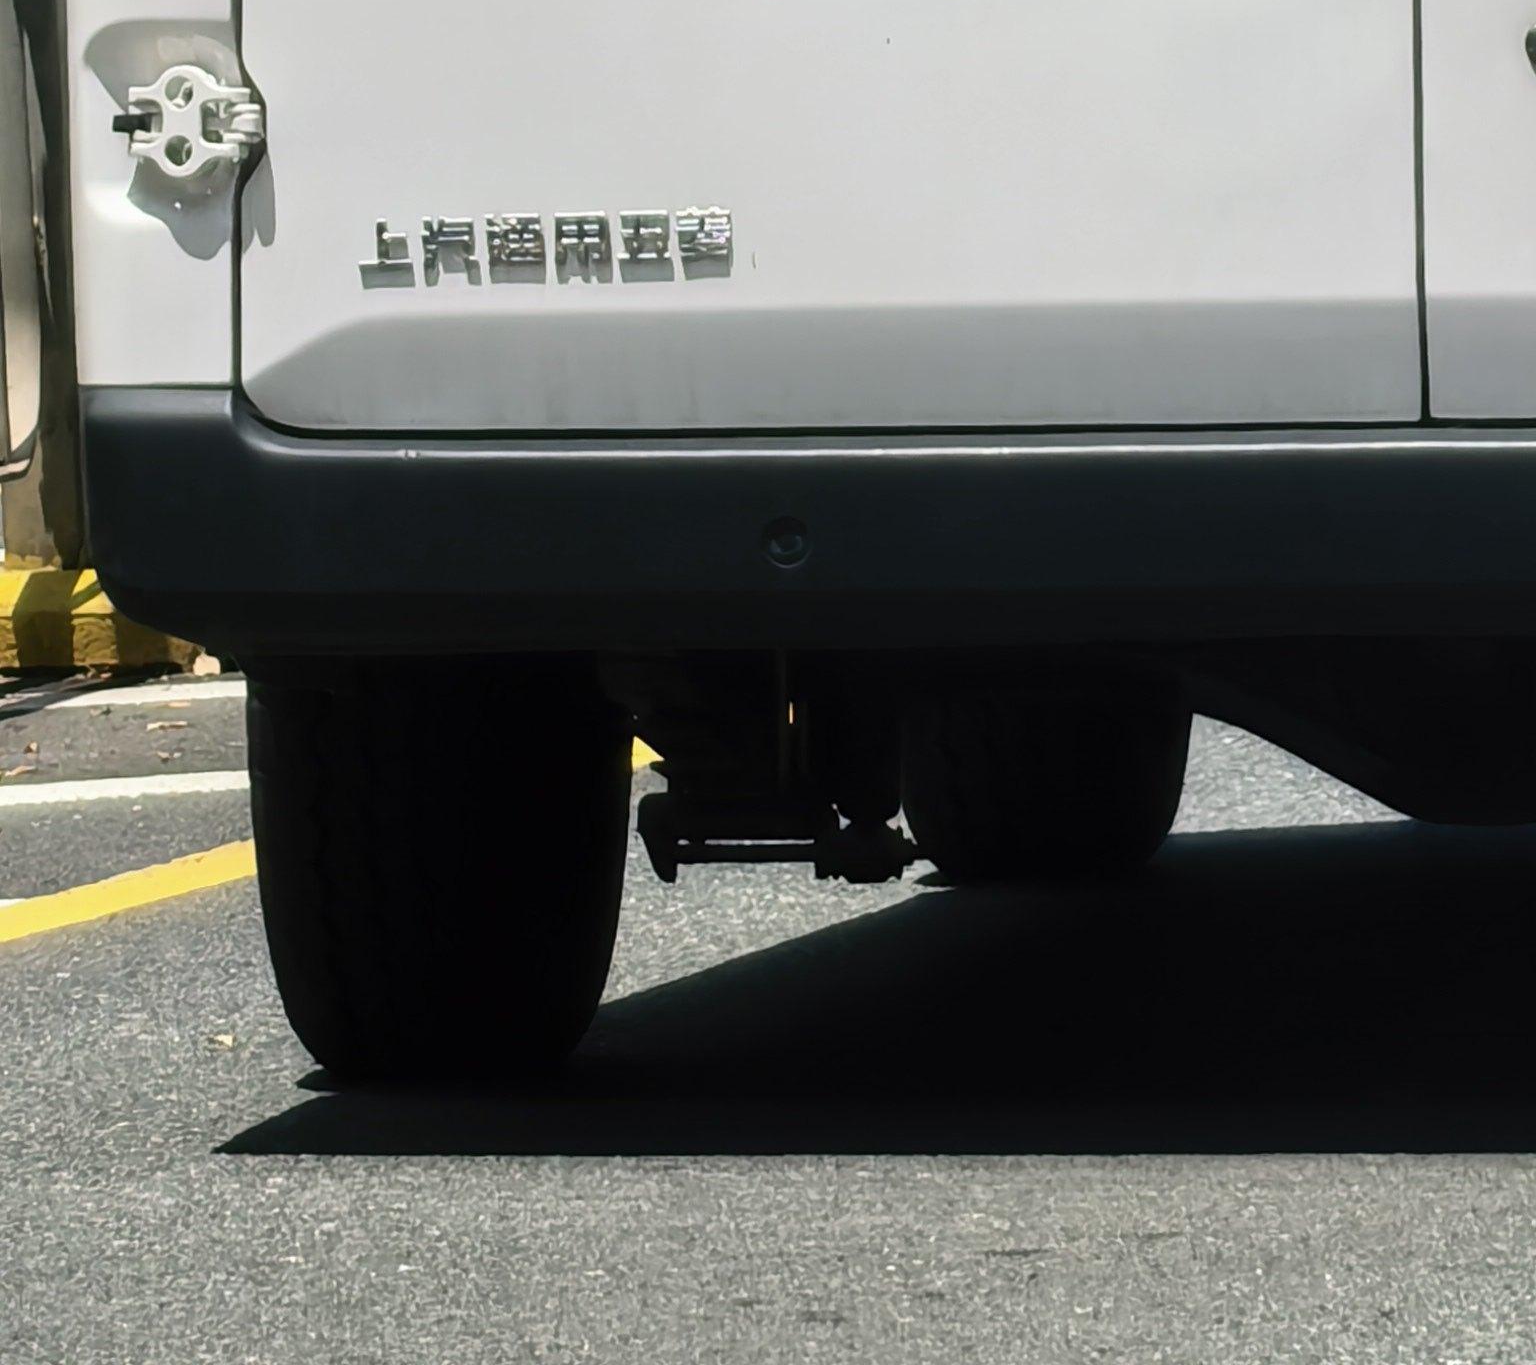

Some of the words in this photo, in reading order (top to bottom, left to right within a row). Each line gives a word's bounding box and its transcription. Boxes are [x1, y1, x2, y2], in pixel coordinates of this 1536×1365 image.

[358, 208, 733, 277] 上汽通用五菱
